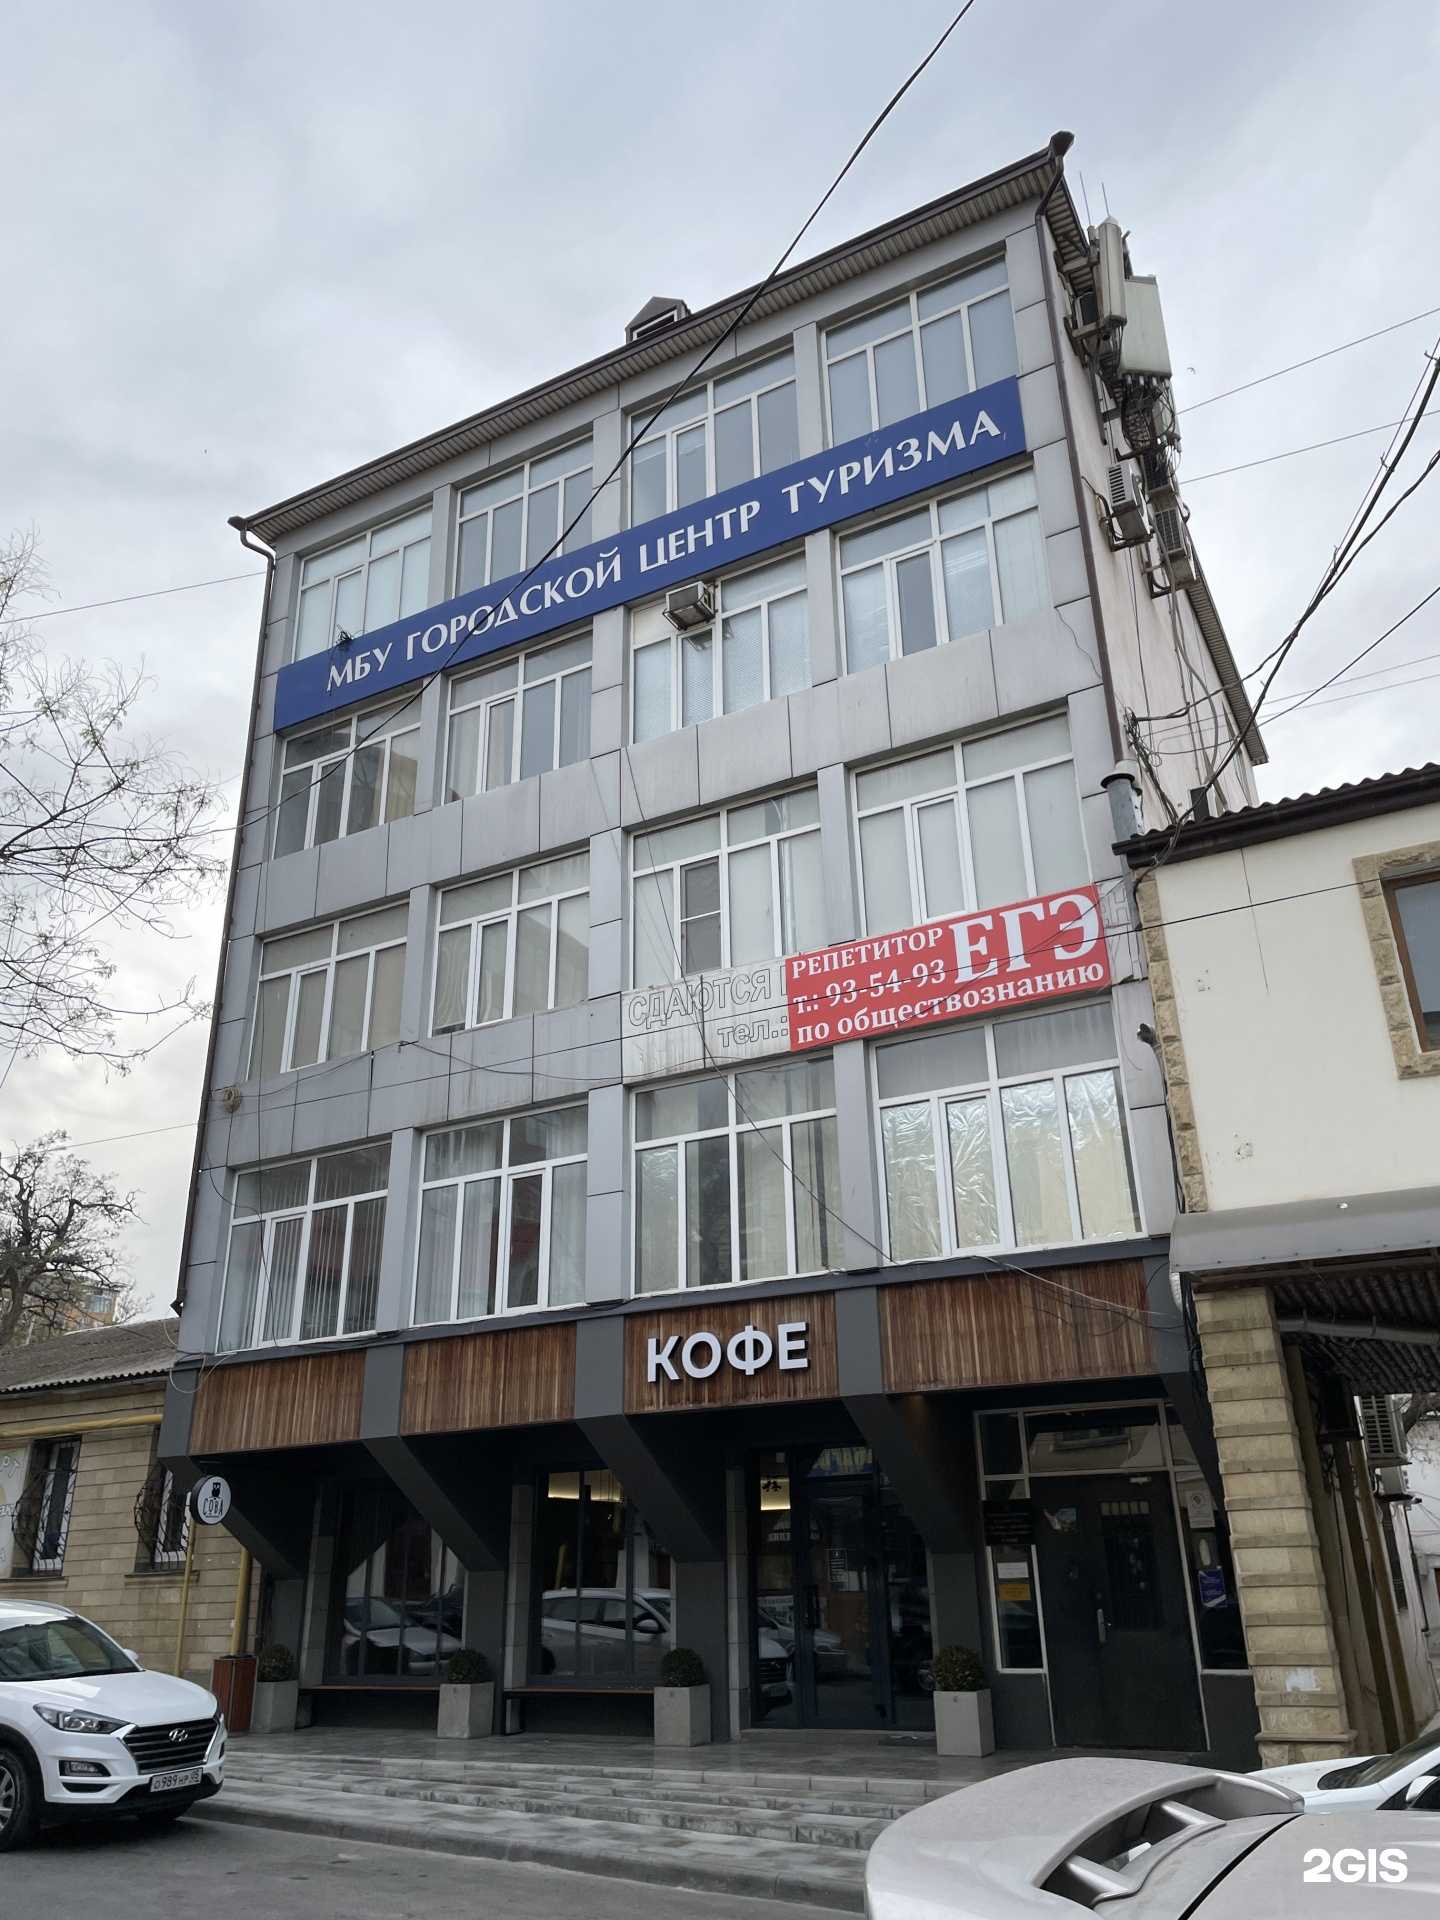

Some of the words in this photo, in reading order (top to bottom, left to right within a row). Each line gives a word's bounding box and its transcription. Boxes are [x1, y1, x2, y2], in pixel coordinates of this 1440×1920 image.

[327, 642, 392, 691] МБУ
[406, 547, 621, 660] ГОРОДСКОЙ
[639, 500, 760, 573] ЦЕНТР
[782, 410, 1001, 514] ТУРИЗМА
[792, 928, 943, 979] РЕПЕТИТОР
[949, 894, 1100, 984] ЕГЭ
[628, 968, 771, 1030] СДАЮТСЯ
[797, 1022, 830, 1044] по
[838, 963, 1104, 1036] обществознанию
[825, 958, 945, 1005] 93-54-93
[648, 1322, 808, 1383] КОФЕ
